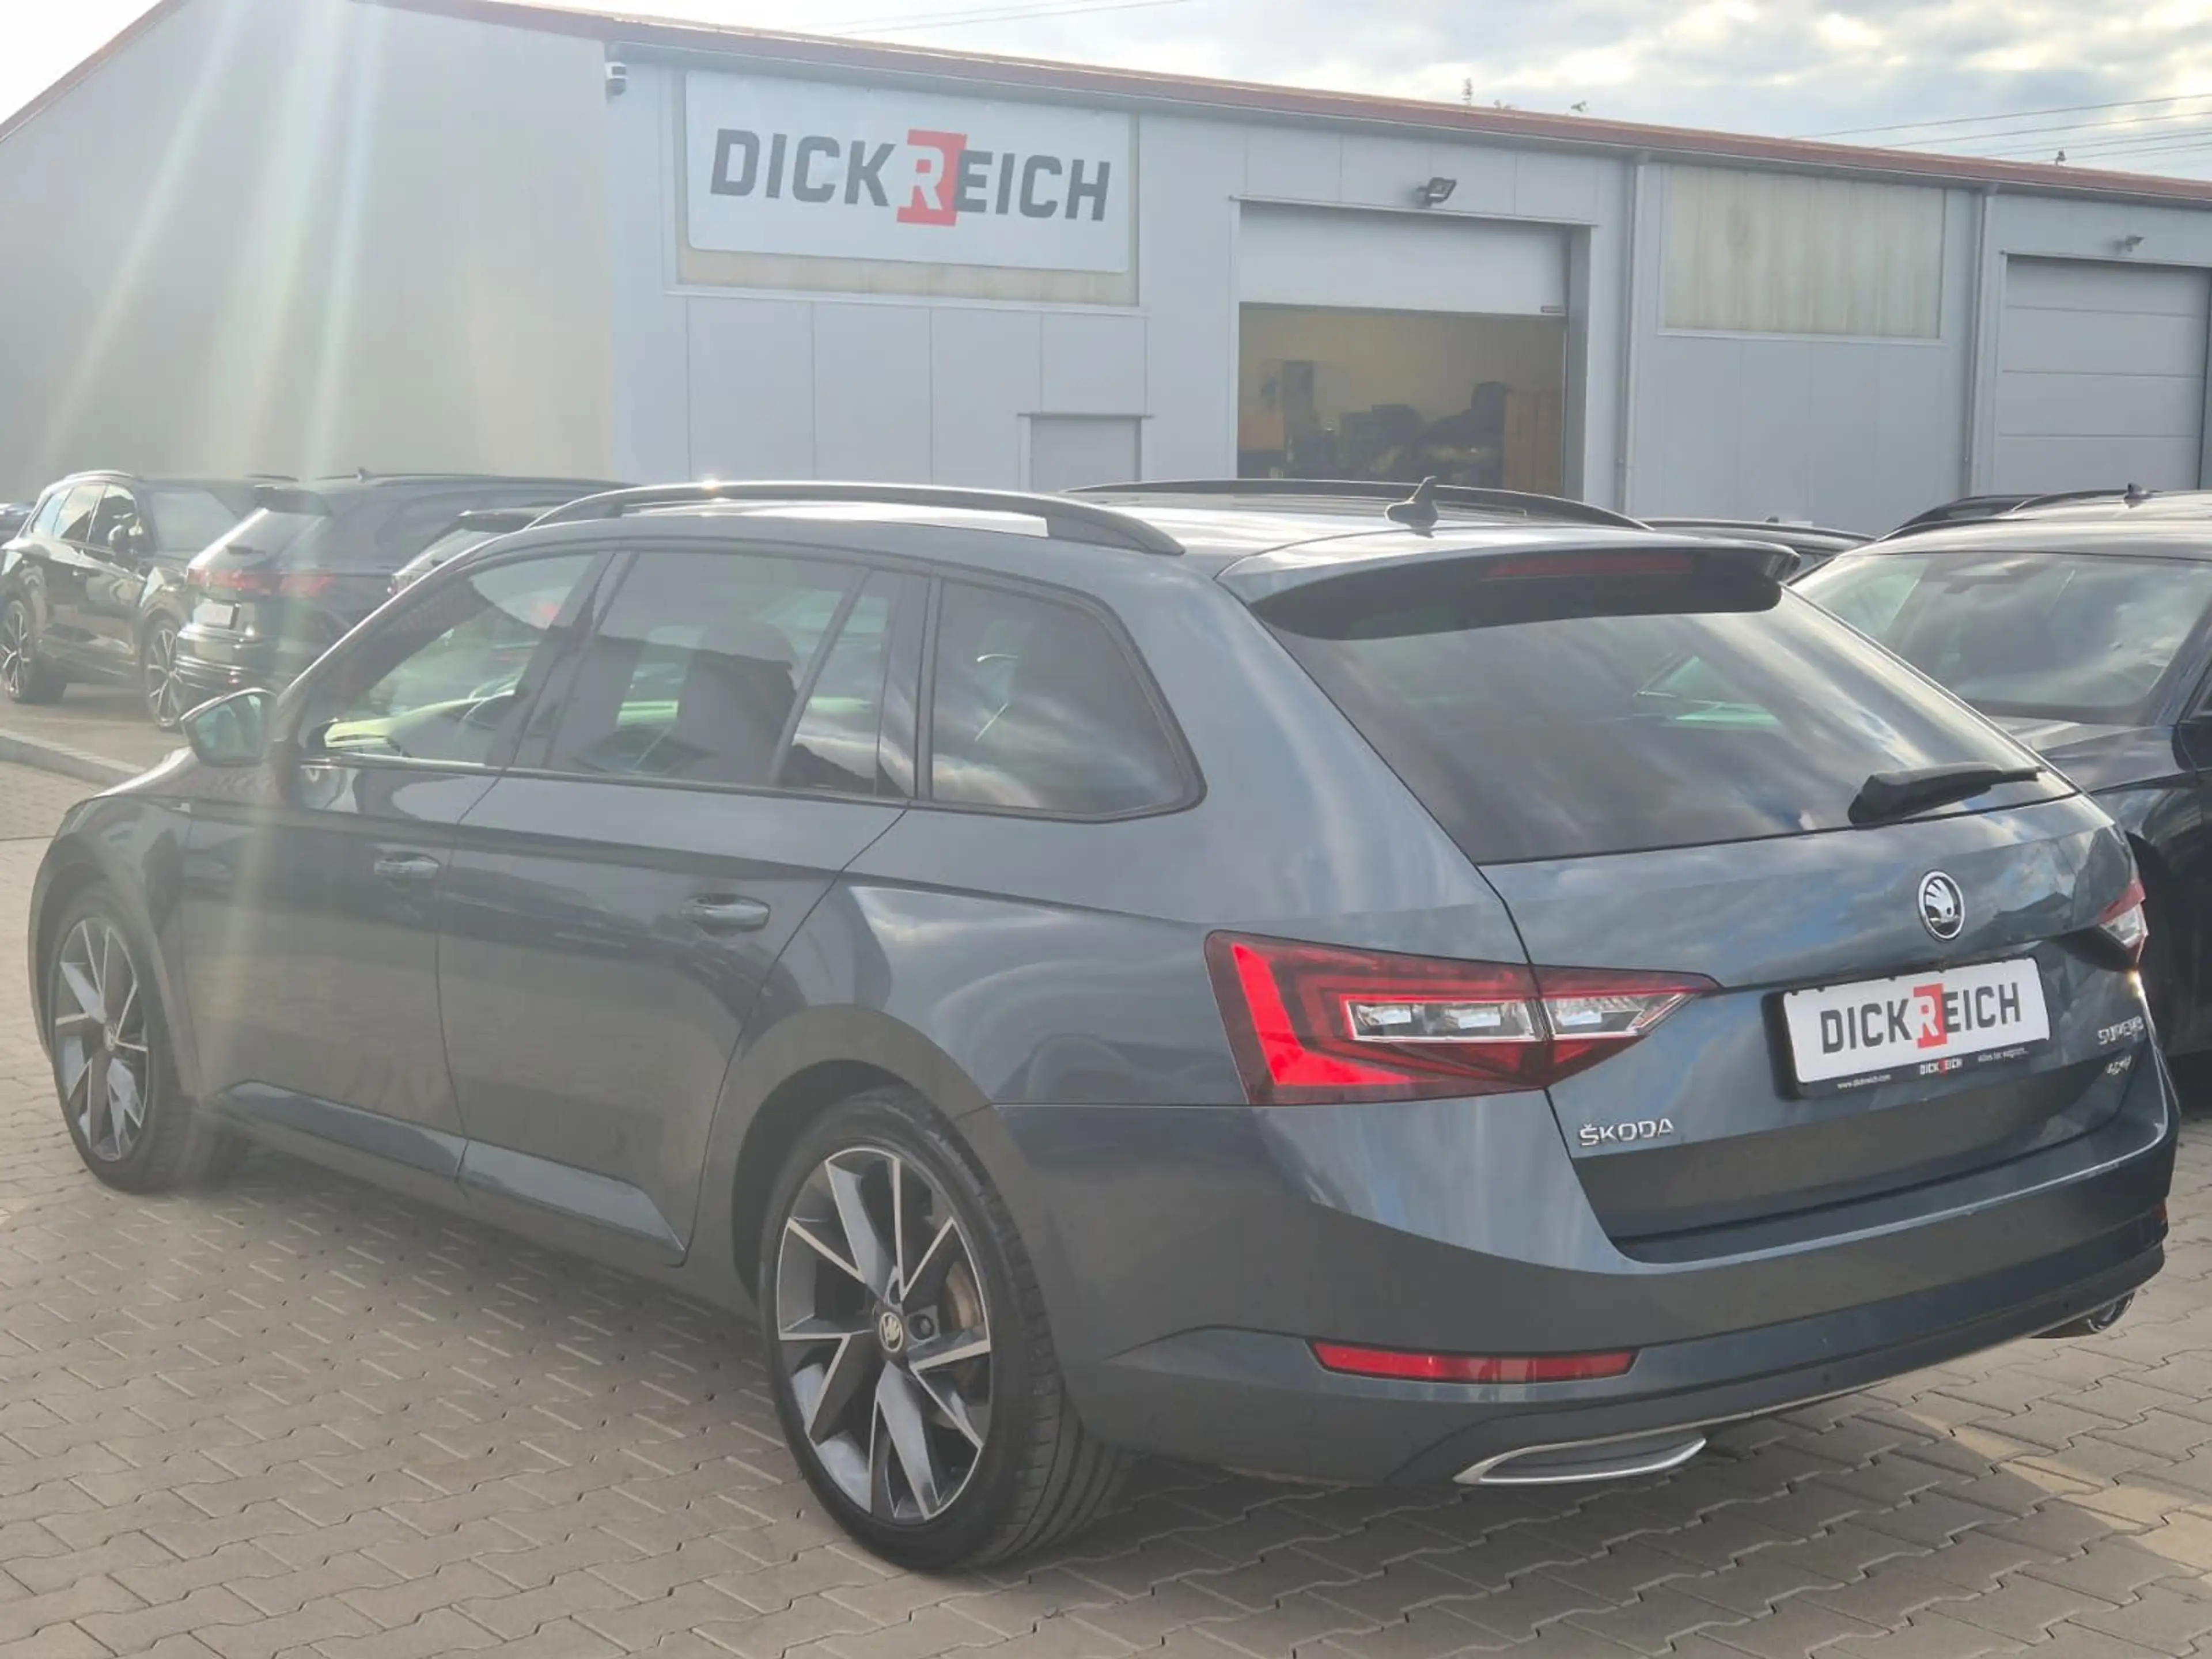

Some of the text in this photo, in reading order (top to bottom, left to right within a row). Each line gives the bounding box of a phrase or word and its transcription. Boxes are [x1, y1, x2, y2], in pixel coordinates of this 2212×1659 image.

[710, 128, 1111, 222] DICKREICH
[1820, 982, 2022, 1054] DICKREICH
[1580, 1118, 1675, 1146] ŠKODA
